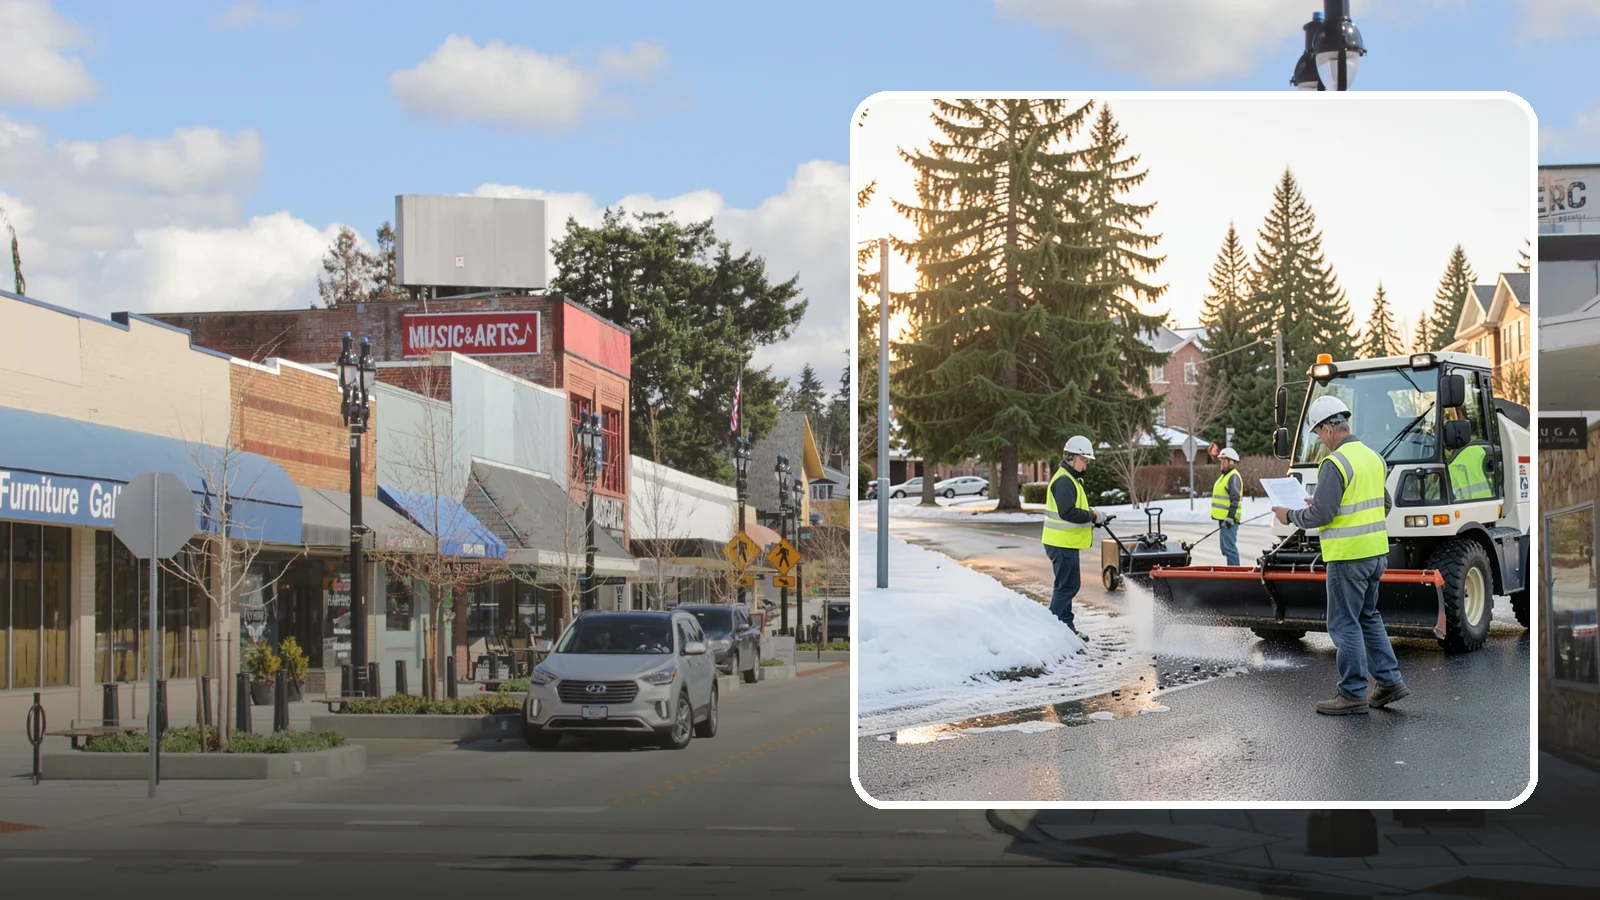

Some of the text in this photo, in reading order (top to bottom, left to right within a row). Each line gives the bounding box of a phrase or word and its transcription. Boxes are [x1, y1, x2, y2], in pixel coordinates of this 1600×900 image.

[409, 323, 519, 349] MUSIC&ARTS
[0, 471, 122, 519] Furniture Gal
